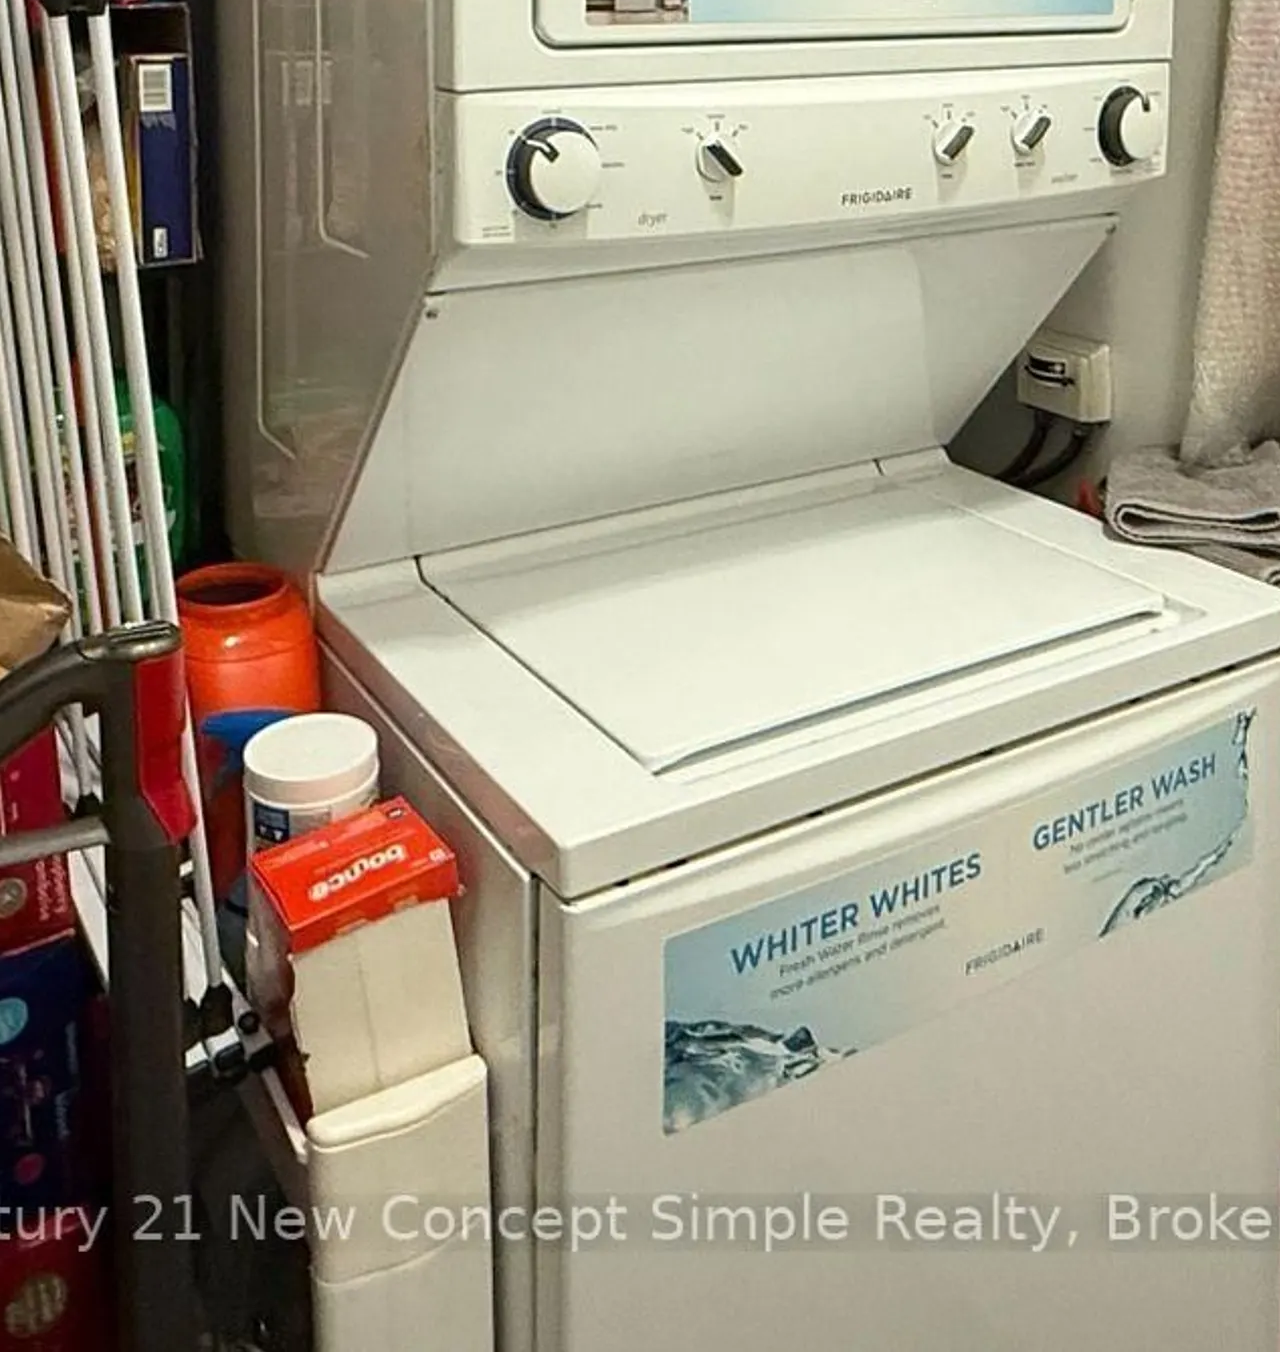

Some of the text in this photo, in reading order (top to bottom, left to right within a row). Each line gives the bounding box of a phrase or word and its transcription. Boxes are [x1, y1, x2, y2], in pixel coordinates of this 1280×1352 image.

[841, 188, 912, 206] FRIGIDAIRE
[1032, 753, 1217, 851] GENTLER WASH
[308, 843, 407, 903] bounce
[731, 853, 982, 974] WHITER WHITES
[770, 980, 804, 999] more
[865, 941, 889, 962] and
[779, 955, 816, 978] Fresh
[820, 939, 854, 962] Water
[858, 924, 890, 945] Rinse
[965, 928, 1045, 976] FRIGIDAIRE
